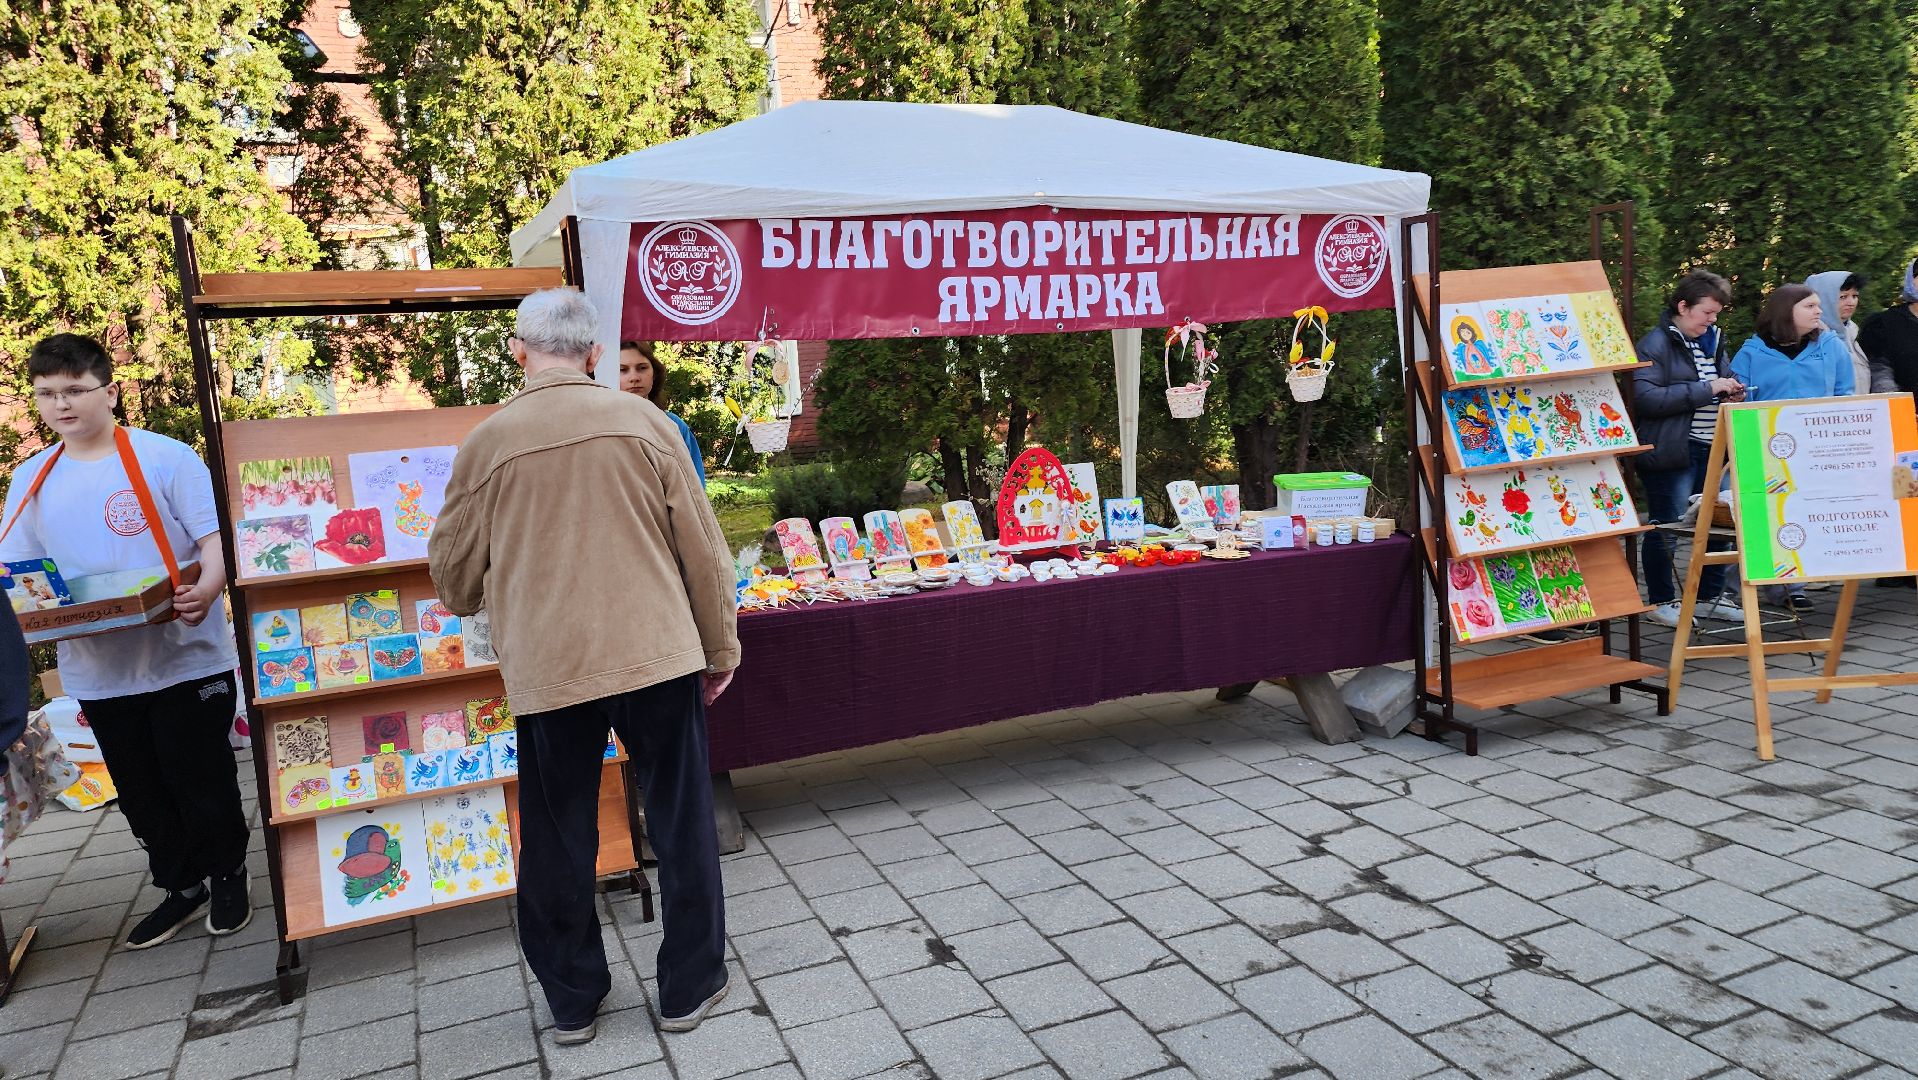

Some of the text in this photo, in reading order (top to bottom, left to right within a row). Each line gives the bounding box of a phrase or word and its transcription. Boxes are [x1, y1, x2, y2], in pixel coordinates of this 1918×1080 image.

[759, 215, 1301, 269] БЛАГОТВОРИТЕЛЬНАЯ
[655, 244, 719, 253] АЛЕКСИЕВСКАЯ
[664, 251, 710, 259] ГИМНАЗИЯ
[938, 272, 1165, 322] ЯРМАРКА
[1804, 413, 1873, 427] ГИМНАЗИЯ
[1808, 428, 1872, 439] 1-11 классы
[1808, 510, 1889, 522] ПОДГОТОВКА
[1834, 523, 1879, 533] ШКОЛЕ
[55, 604, 124, 624] гимназия
